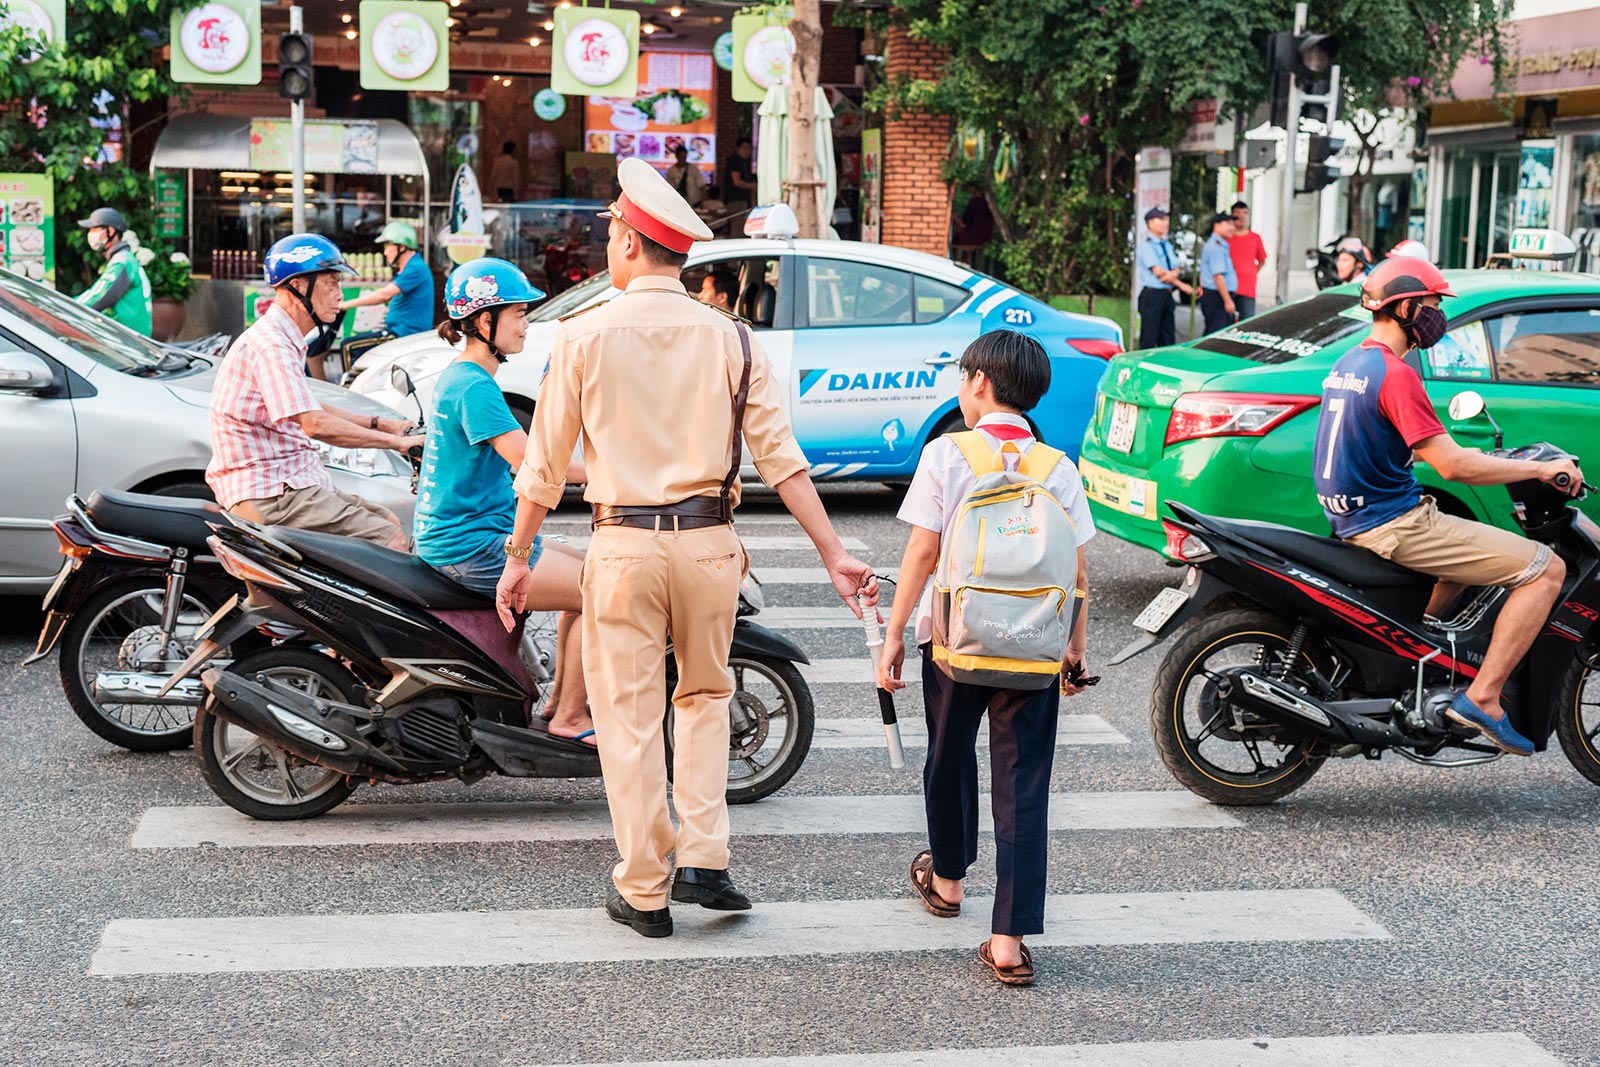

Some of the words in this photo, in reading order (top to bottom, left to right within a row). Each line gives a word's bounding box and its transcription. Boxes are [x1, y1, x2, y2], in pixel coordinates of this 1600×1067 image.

[1005, 308, 1033, 325] 271
[827, 370, 937, 392] DAIKIN
[1322, 398, 1345, 479] 7
[983, 618, 1008, 629] Proud
